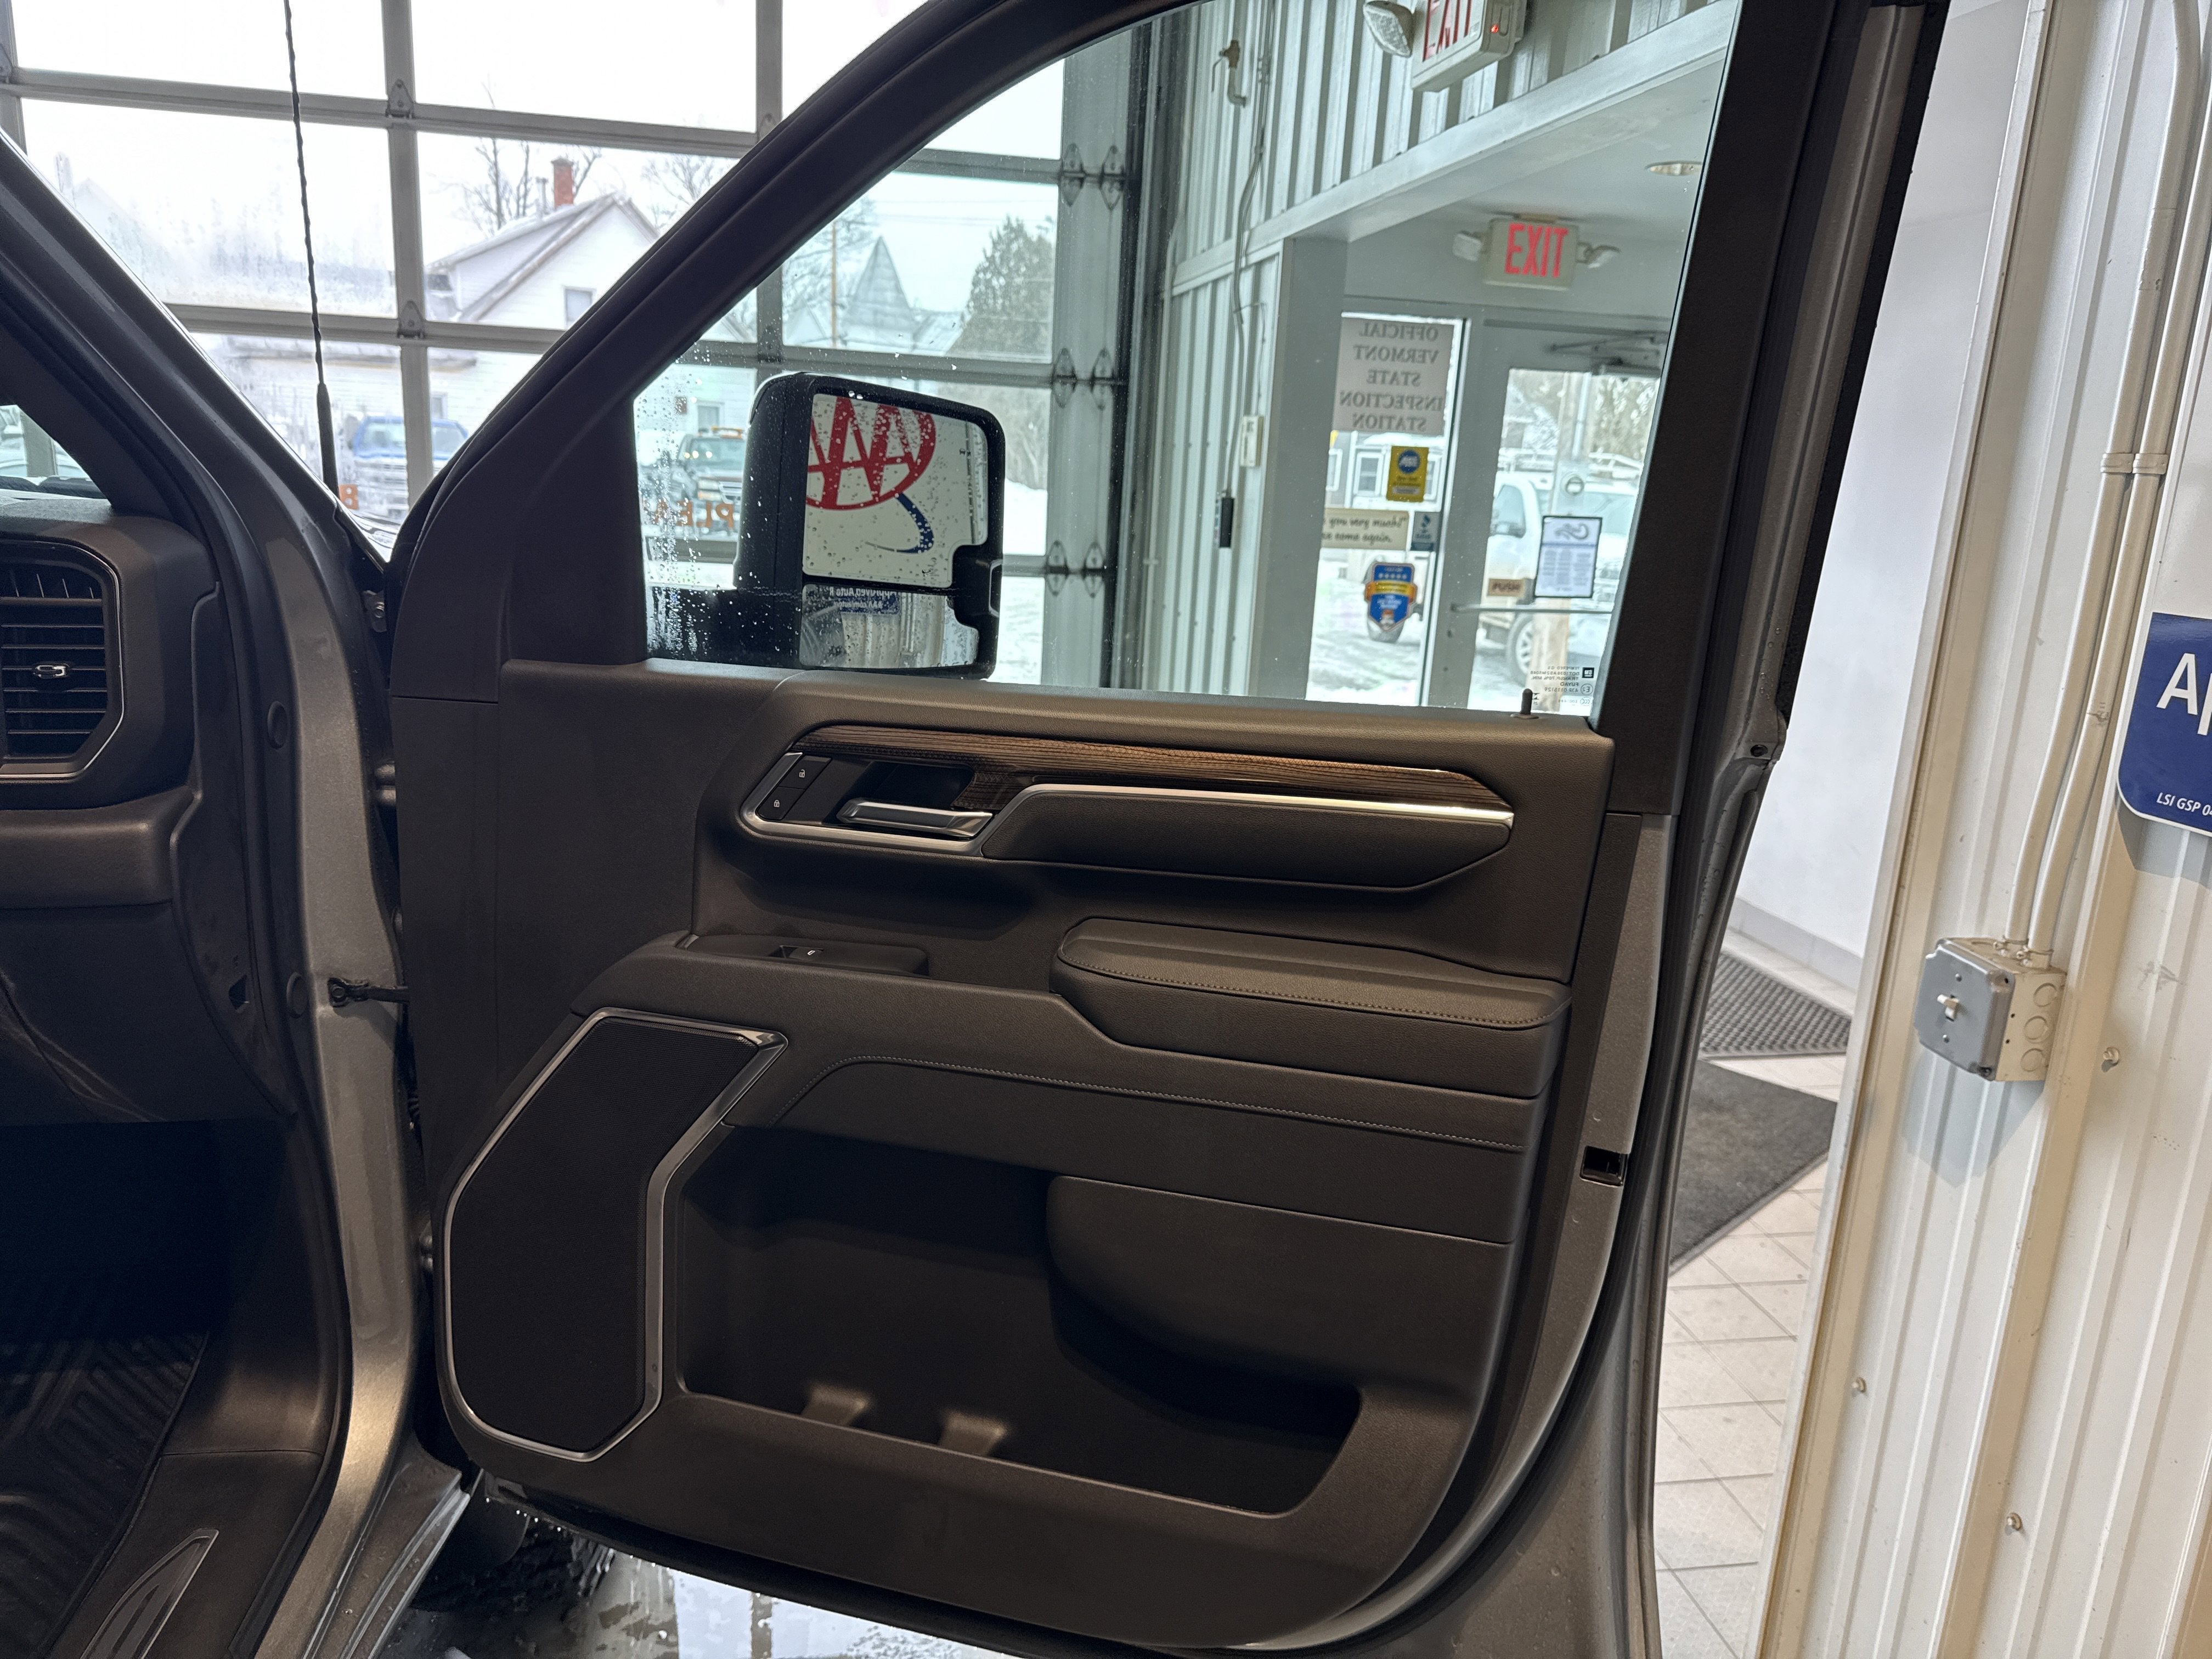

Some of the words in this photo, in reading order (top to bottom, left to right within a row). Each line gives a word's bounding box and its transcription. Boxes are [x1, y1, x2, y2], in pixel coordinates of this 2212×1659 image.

[1504, 223, 1569, 278] EXIT
[2156, 792, 2176, 806] LSI
[2176, 797, 2201, 812] GSP
